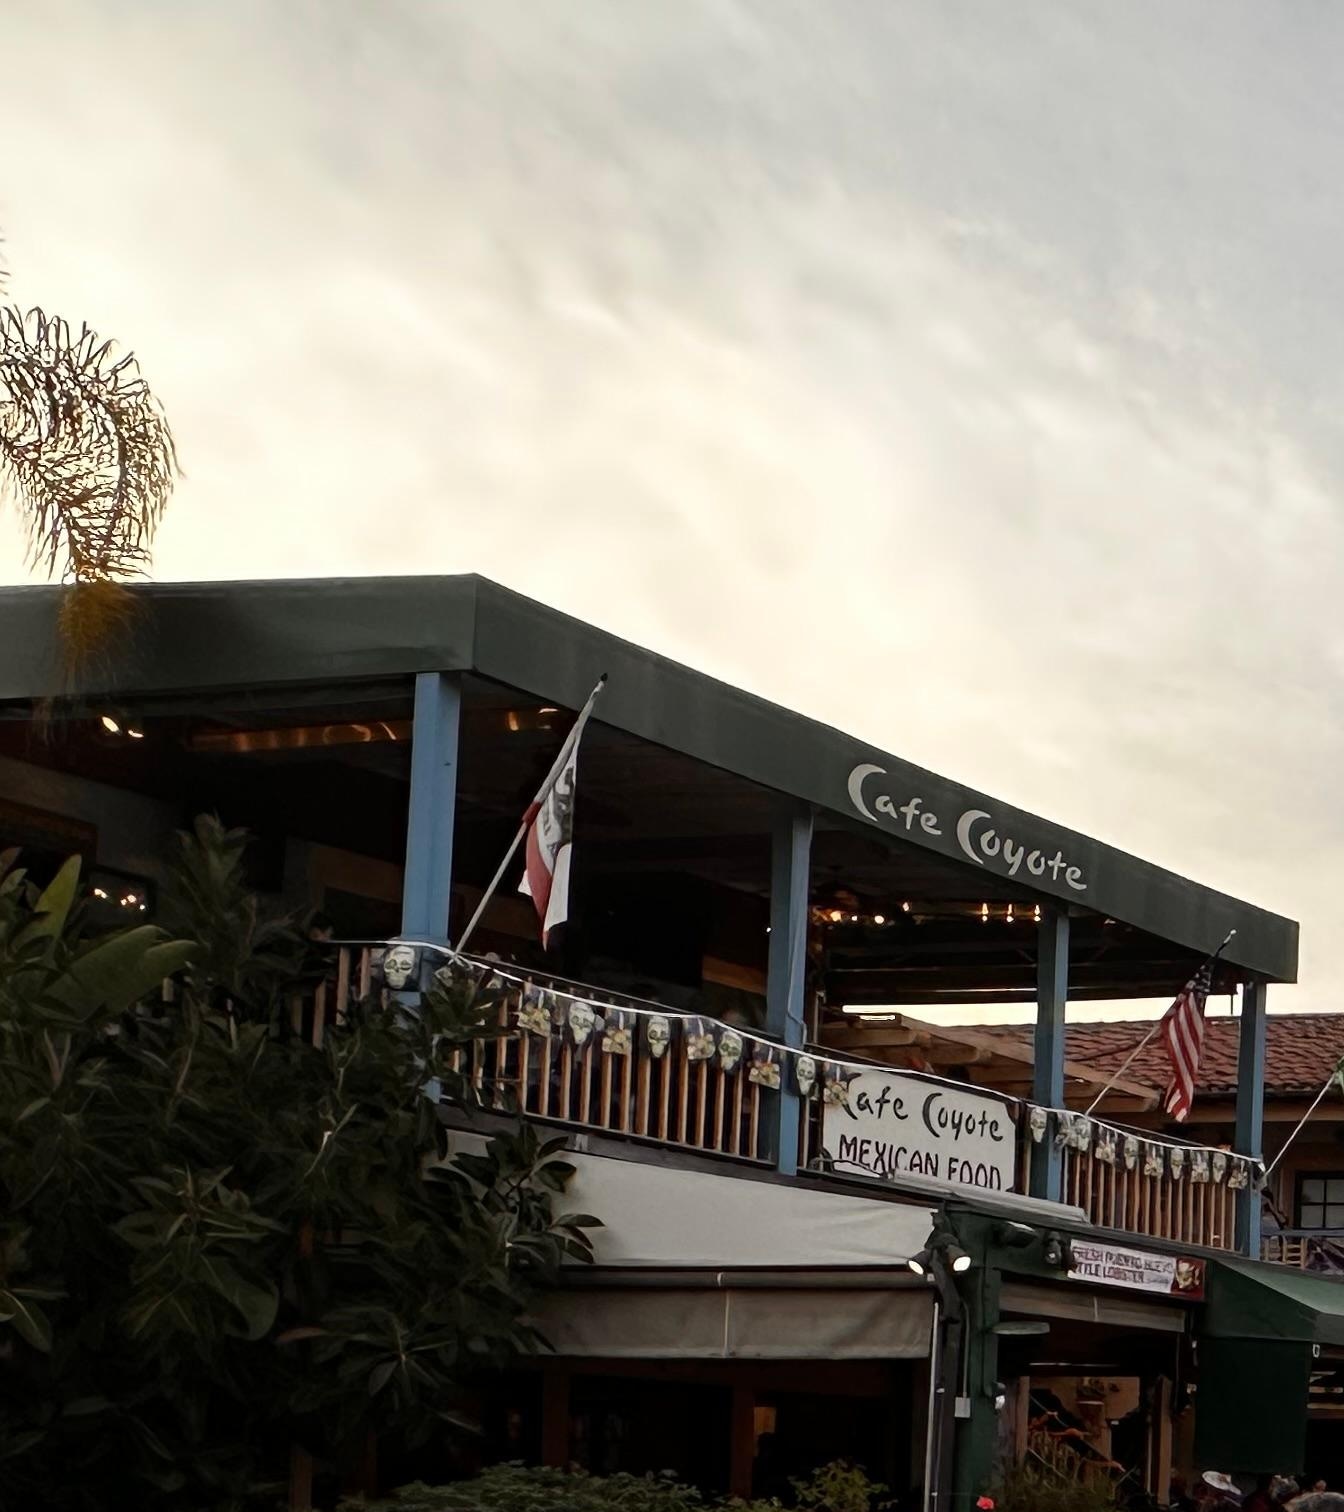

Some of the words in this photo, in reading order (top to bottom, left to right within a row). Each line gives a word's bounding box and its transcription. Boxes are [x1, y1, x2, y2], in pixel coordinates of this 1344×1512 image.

[847, 763, 943, 836] Cafe
[956, 809, 1088, 891] Coyote
[841, 1072, 909, 1121] Cafe
[922, 1092, 1004, 1142] Coyote
[839, 1133, 940, 1178] MEXICAN
[948, 1156, 1002, 1191] FOOD
